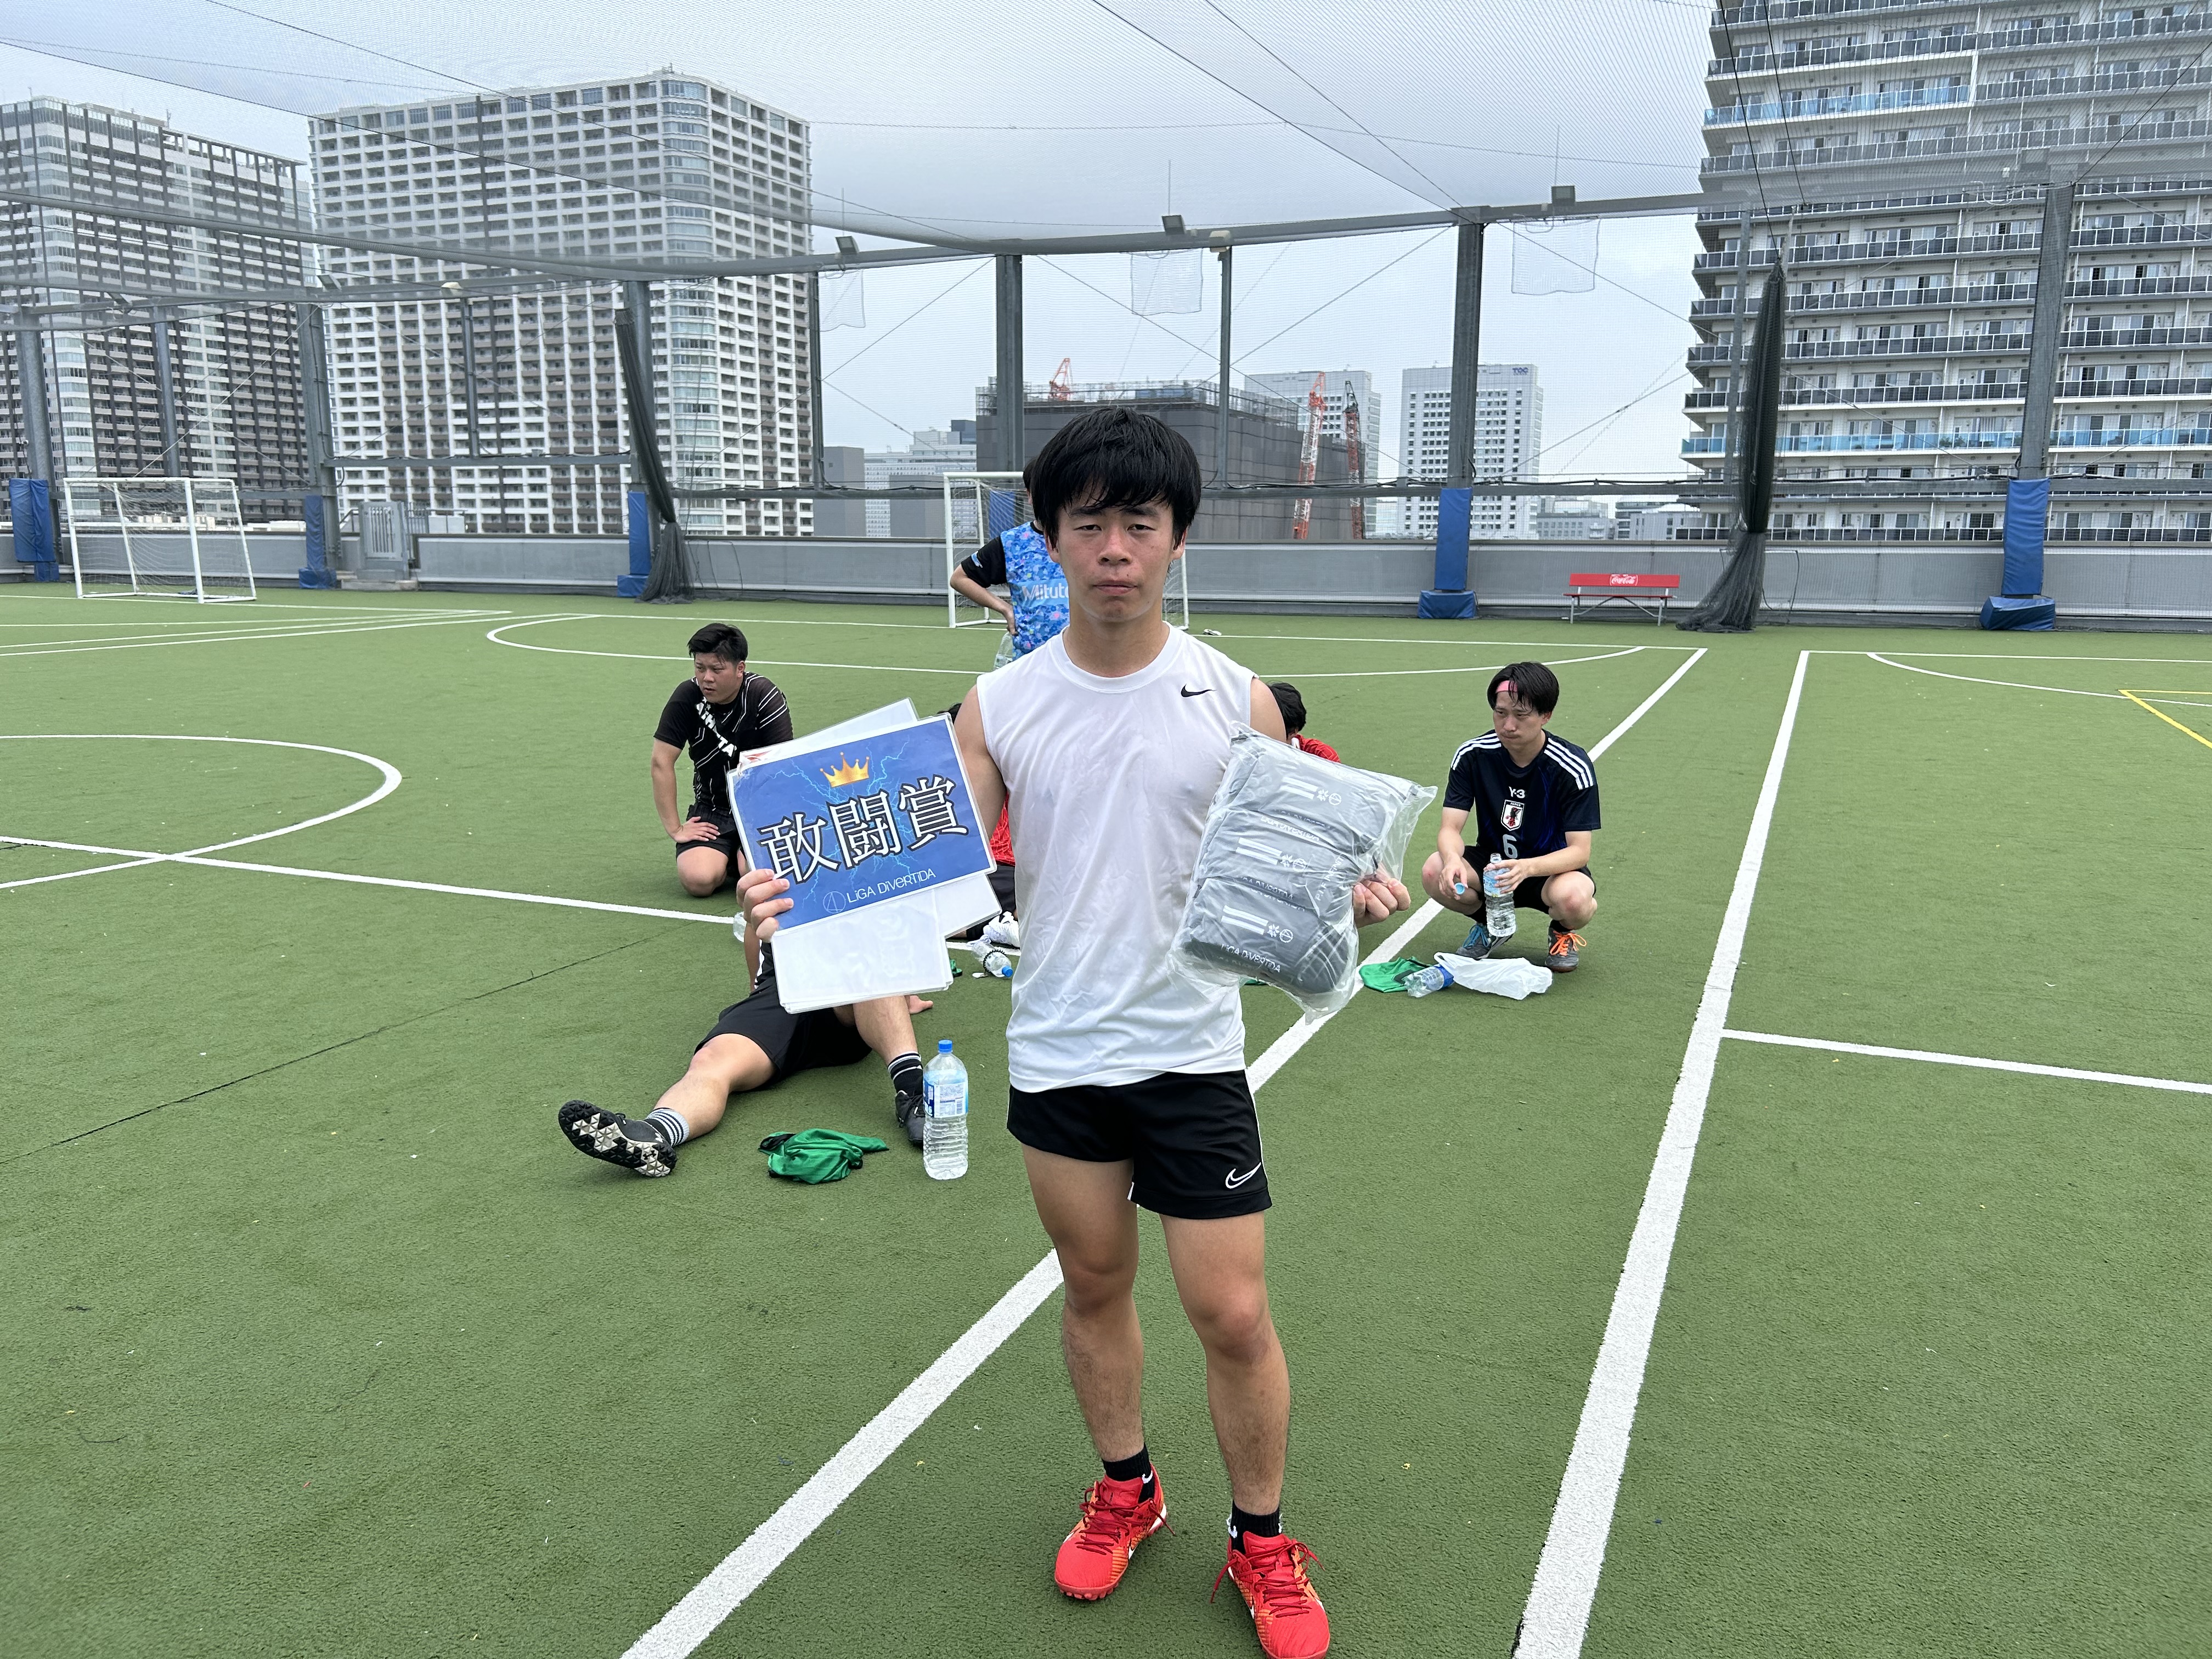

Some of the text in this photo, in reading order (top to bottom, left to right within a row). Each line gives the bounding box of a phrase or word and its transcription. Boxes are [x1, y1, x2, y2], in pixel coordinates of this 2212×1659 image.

[1509, 786, 1525, 799] Y-3
[759, 774, 969, 884] 敢闘賞
[1502, 834, 1518, 860] 6
